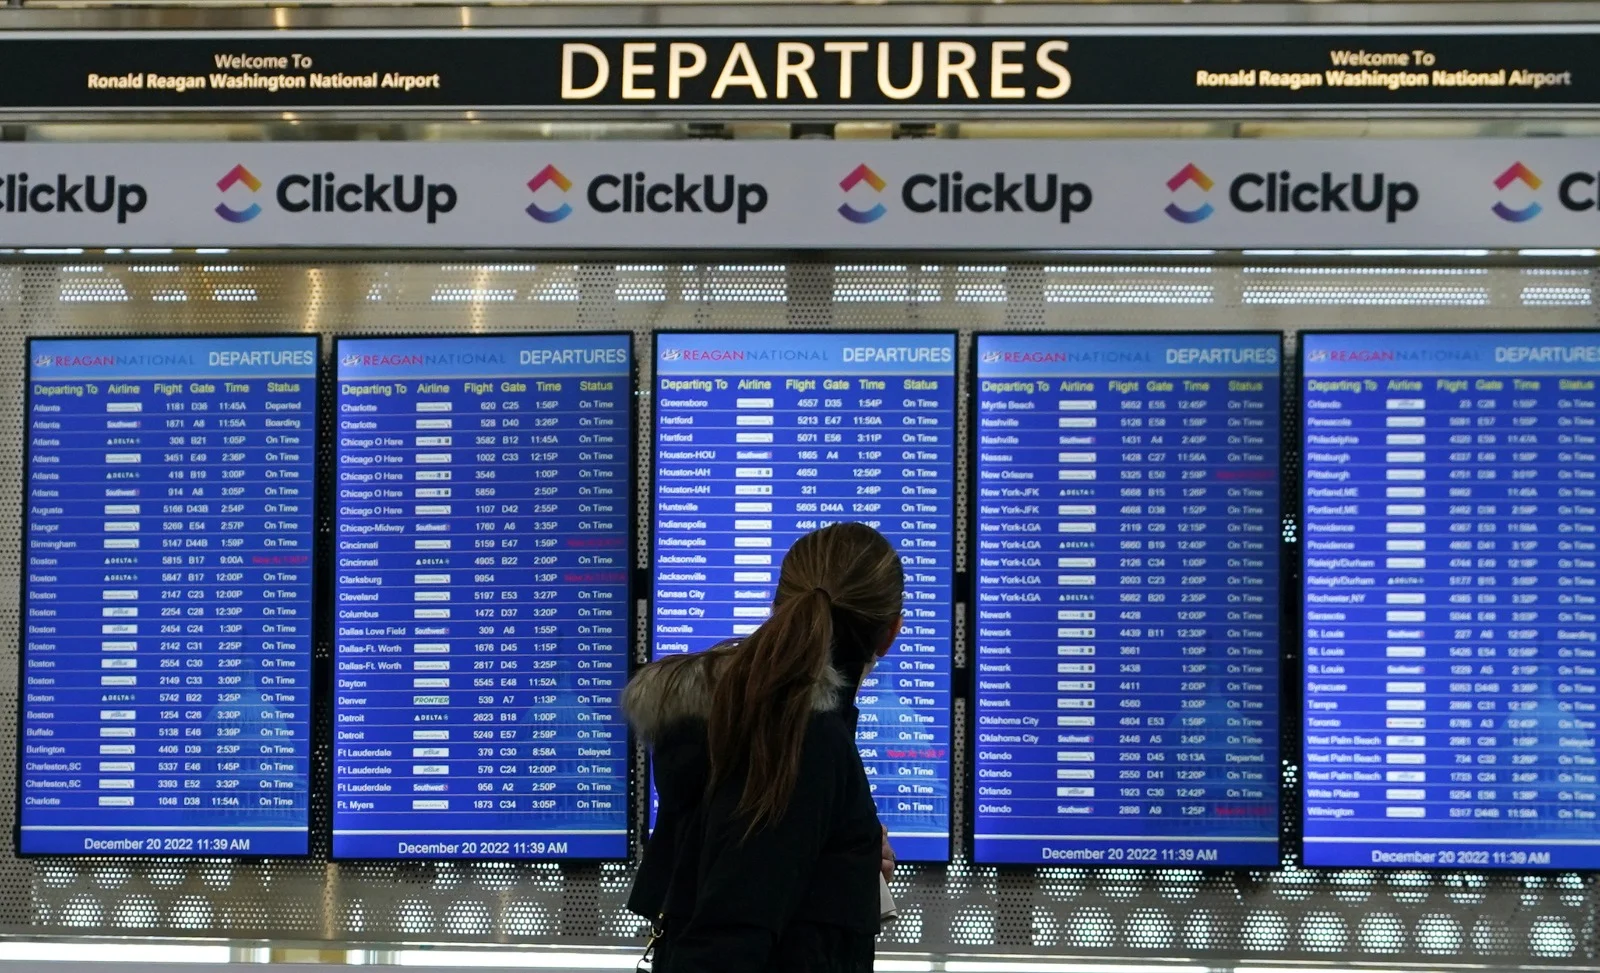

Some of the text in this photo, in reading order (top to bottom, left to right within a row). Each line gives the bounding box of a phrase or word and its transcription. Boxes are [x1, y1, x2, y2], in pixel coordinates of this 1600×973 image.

[215, 54, 312, 69] Welcome To
[1331, 50, 1435, 66] Welcome To
[561, 42, 1072, 100] DEPARTURES
[88, 73, 439, 92] Ronald Reagan Washington National Airport
[1197, 70, 1570, 90] Ronald Reagan Washington National Airport
[277, 172, 457, 224] ClickUp
[587, 172, 768, 224] ClickUp
[902, 171, 1092, 223] ClickUp
[1229, 170, 1419, 223] ClickUp
[209, 351, 314, 366] DEPARTURES
[520, 349, 626, 365] DEPARTURES
[843, 348, 951, 362] DEPARTURES
[1166, 348, 1276, 364] DEPARTURES
[34, 382, 300, 397] Departing To Airline Flight Gate Time Status
[342, 381, 613, 397] Departing To Airline Flight Gate Time Status
[661, 379, 937, 392] Departing To Airline Flight Gate Time Status
[982, 380, 1262, 394] Departing To Airline Flight Gate Time Status
[1308, 379, 1594, 393] Departing To Airline Flight Gate Time Status
[34, 404, 60, 412] Atlanta
[220, 402, 246, 410] 11:45A
[265, 402, 301, 411] Departed
[660, 451, 937, 460] Houston-HOU 1865 A4 1:10P On Time
[387, 627, 406, 635] Field
[503, 626, 515, 634] A6
[592, 625, 612, 633] Time
[657, 642, 935, 652] Lansing On Time
[338, 697, 367, 705] Denver
[534, 695, 556, 703] 1:13P
[591, 695, 612, 703] Time
[1308, 701, 1338, 711] Tampa
[979, 716, 1039, 727] Oklahoma City
[1308, 718, 1341, 726] Toronto
[348, 749, 392, 757] Lauderdale
[478, 748, 493, 756] 379
[500, 748, 517, 756] C30
[533, 748, 556, 756] 8:58A
[578, 748, 611, 757] Delayed
[979, 787, 1012, 795] Orlando
[1121, 788, 1140, 796] 1923
[1177, 789, 1205, 797] 12:42P
[1227, 789, 1240, 797] On
[1242, 789, 1262, 797] Time
[25, 797, 293, 805] Charlotte 1048 D38 11:54A On Time
[337, 801, 347, 809] Ft.
[350, 801, 374, 810] Myers
[532, 800, 556, 808] 3:05P
[577, 800, 589, 808] On
[591, 800, 611, 808] Time
[85, 838, 250, 850] December 20 2022 11:39 AM
[399, 842, 567, 853] December 20 2022 11:39 AM
[1042, 848, 1217, 860] December 20 2022 11:39 AM
[1372, 850, 1550, 864] December 20 2022 11:39 AM
